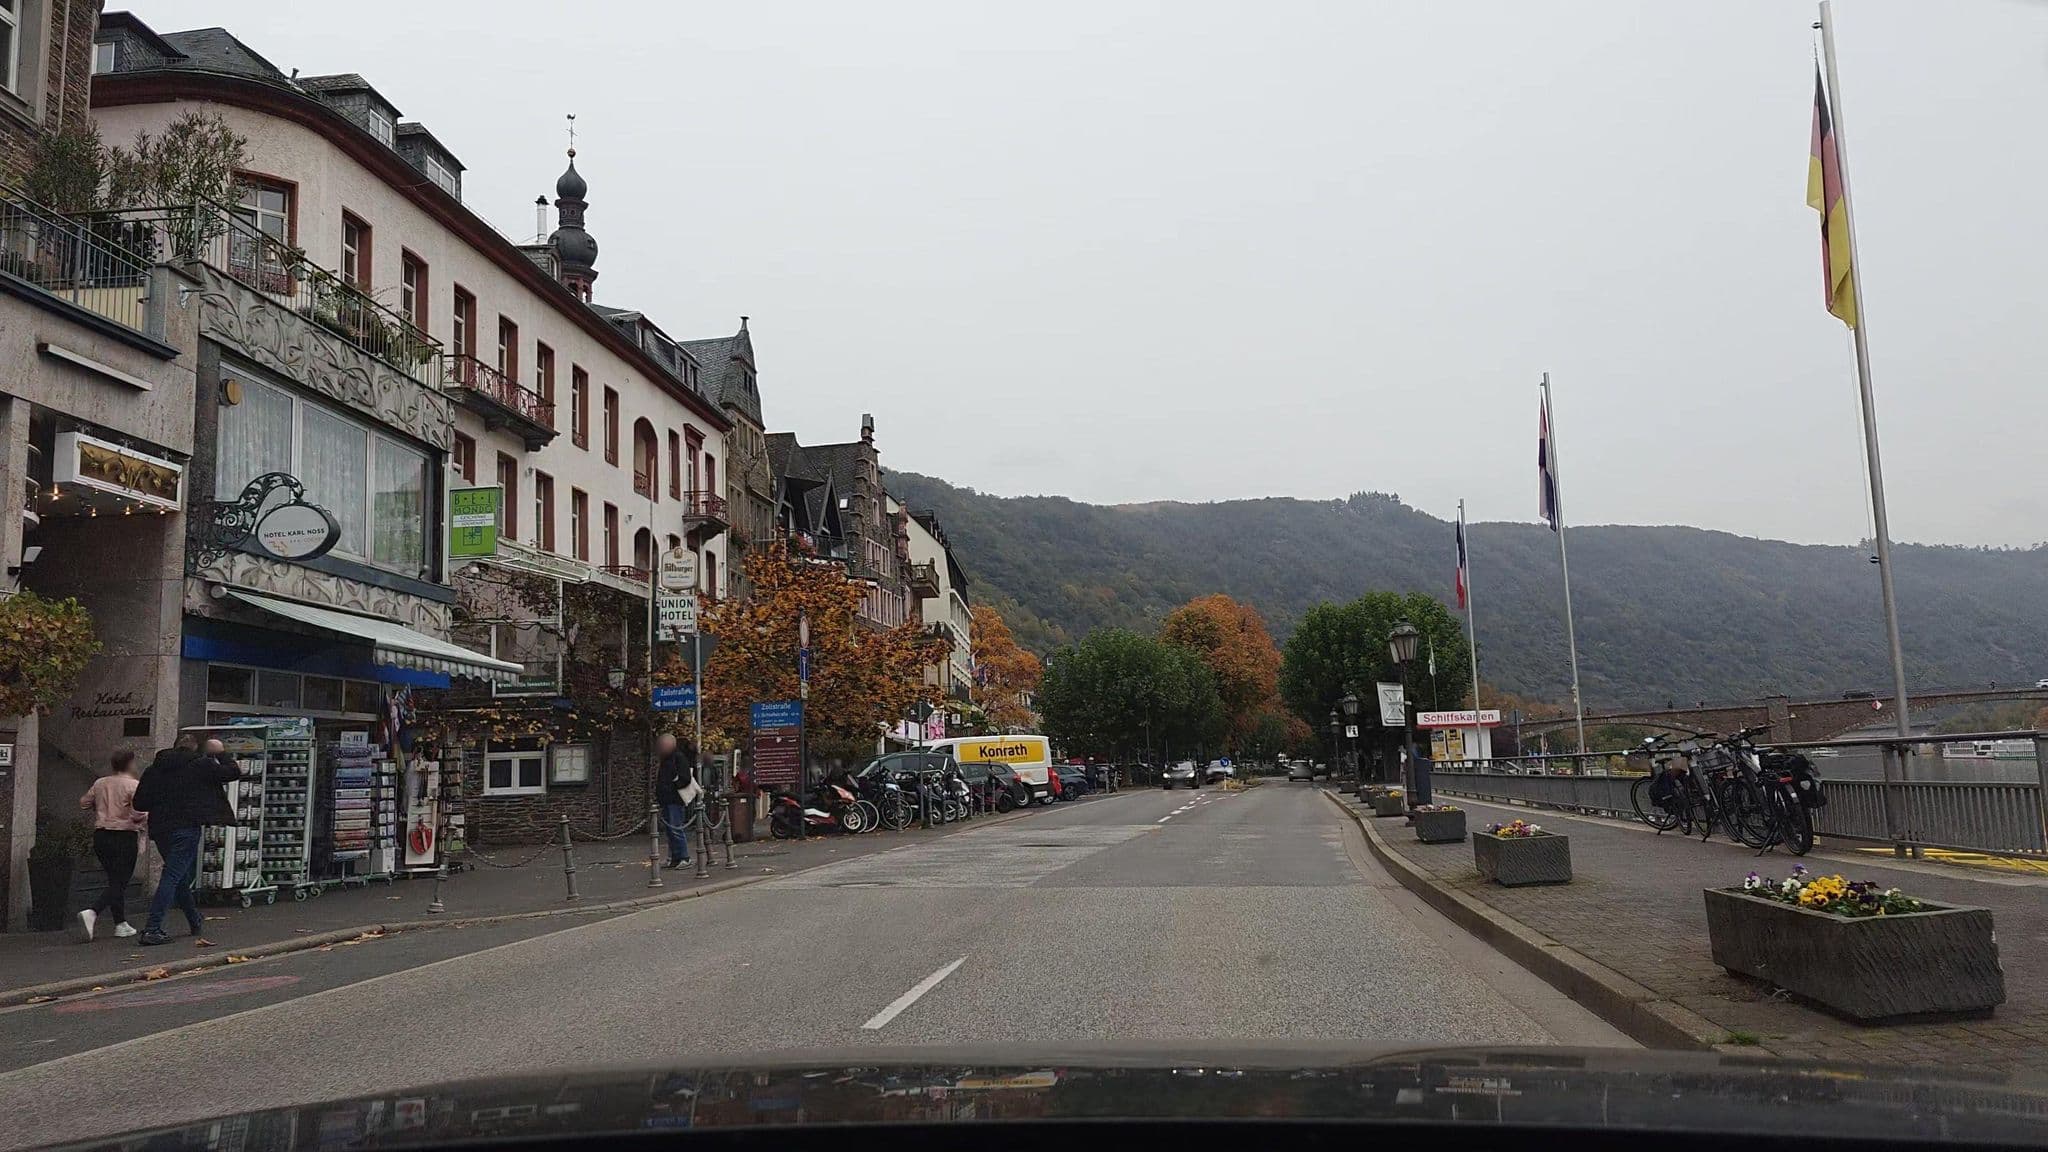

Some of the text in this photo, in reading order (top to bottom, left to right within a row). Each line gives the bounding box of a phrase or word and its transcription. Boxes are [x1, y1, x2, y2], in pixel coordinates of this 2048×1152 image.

[263, 527, 326, 539] HOTEL KARL NOSS
[663, 562, 694, 573] Bitburger
[661, 598, 694, 609] UNION
[660, 610, 694, 620] HOTEL
[95, 691, 133, 705] Hotel
[72, 704, 154, 720] Restaurant
[1423, 711, 1495, 723] Schiffskaren
[979, 743, 1028, 758] Konrath
